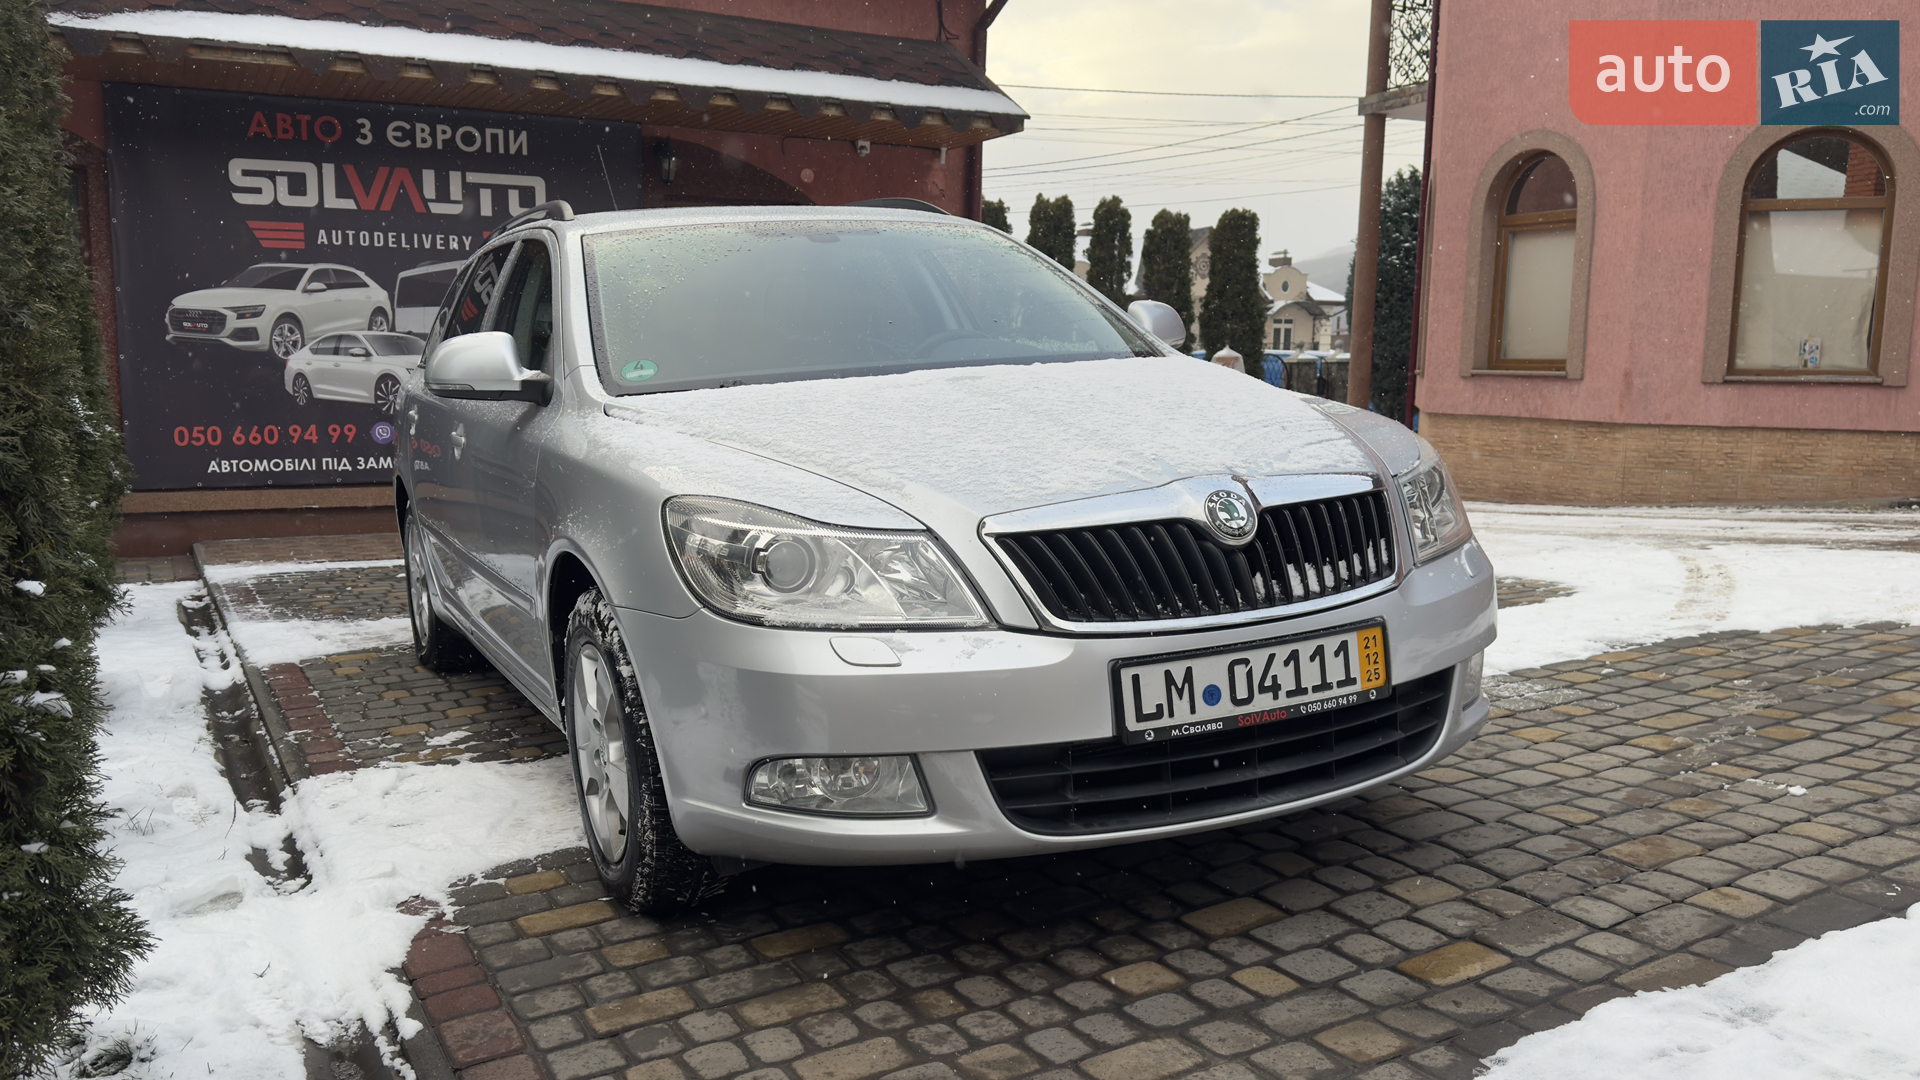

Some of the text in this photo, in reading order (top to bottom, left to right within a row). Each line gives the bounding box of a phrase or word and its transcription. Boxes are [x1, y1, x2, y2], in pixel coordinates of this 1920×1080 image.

[246, 111, 342, 142] АВТО
[386, 120, 528, 155] ЄВРОПИ
[228, 158, 546, 218] SOLVAUTO
[317, 228, 472, 251] AUTODELIVERY
[173, 424, 357, 446] 050 660 94 99
[207, 458, 315, 473] АВТОМОБІЛІ
[322, 458, 352, 471] ПІД
[1363, 634, 1378, 650] 21
[1365, 651, 1380, 666] 12
[1131, 639, 1357, 723] LM 04111
[1366, 667, 1381, 683] 25
[1307, 694, 1357, 712] 050 660 94 99
